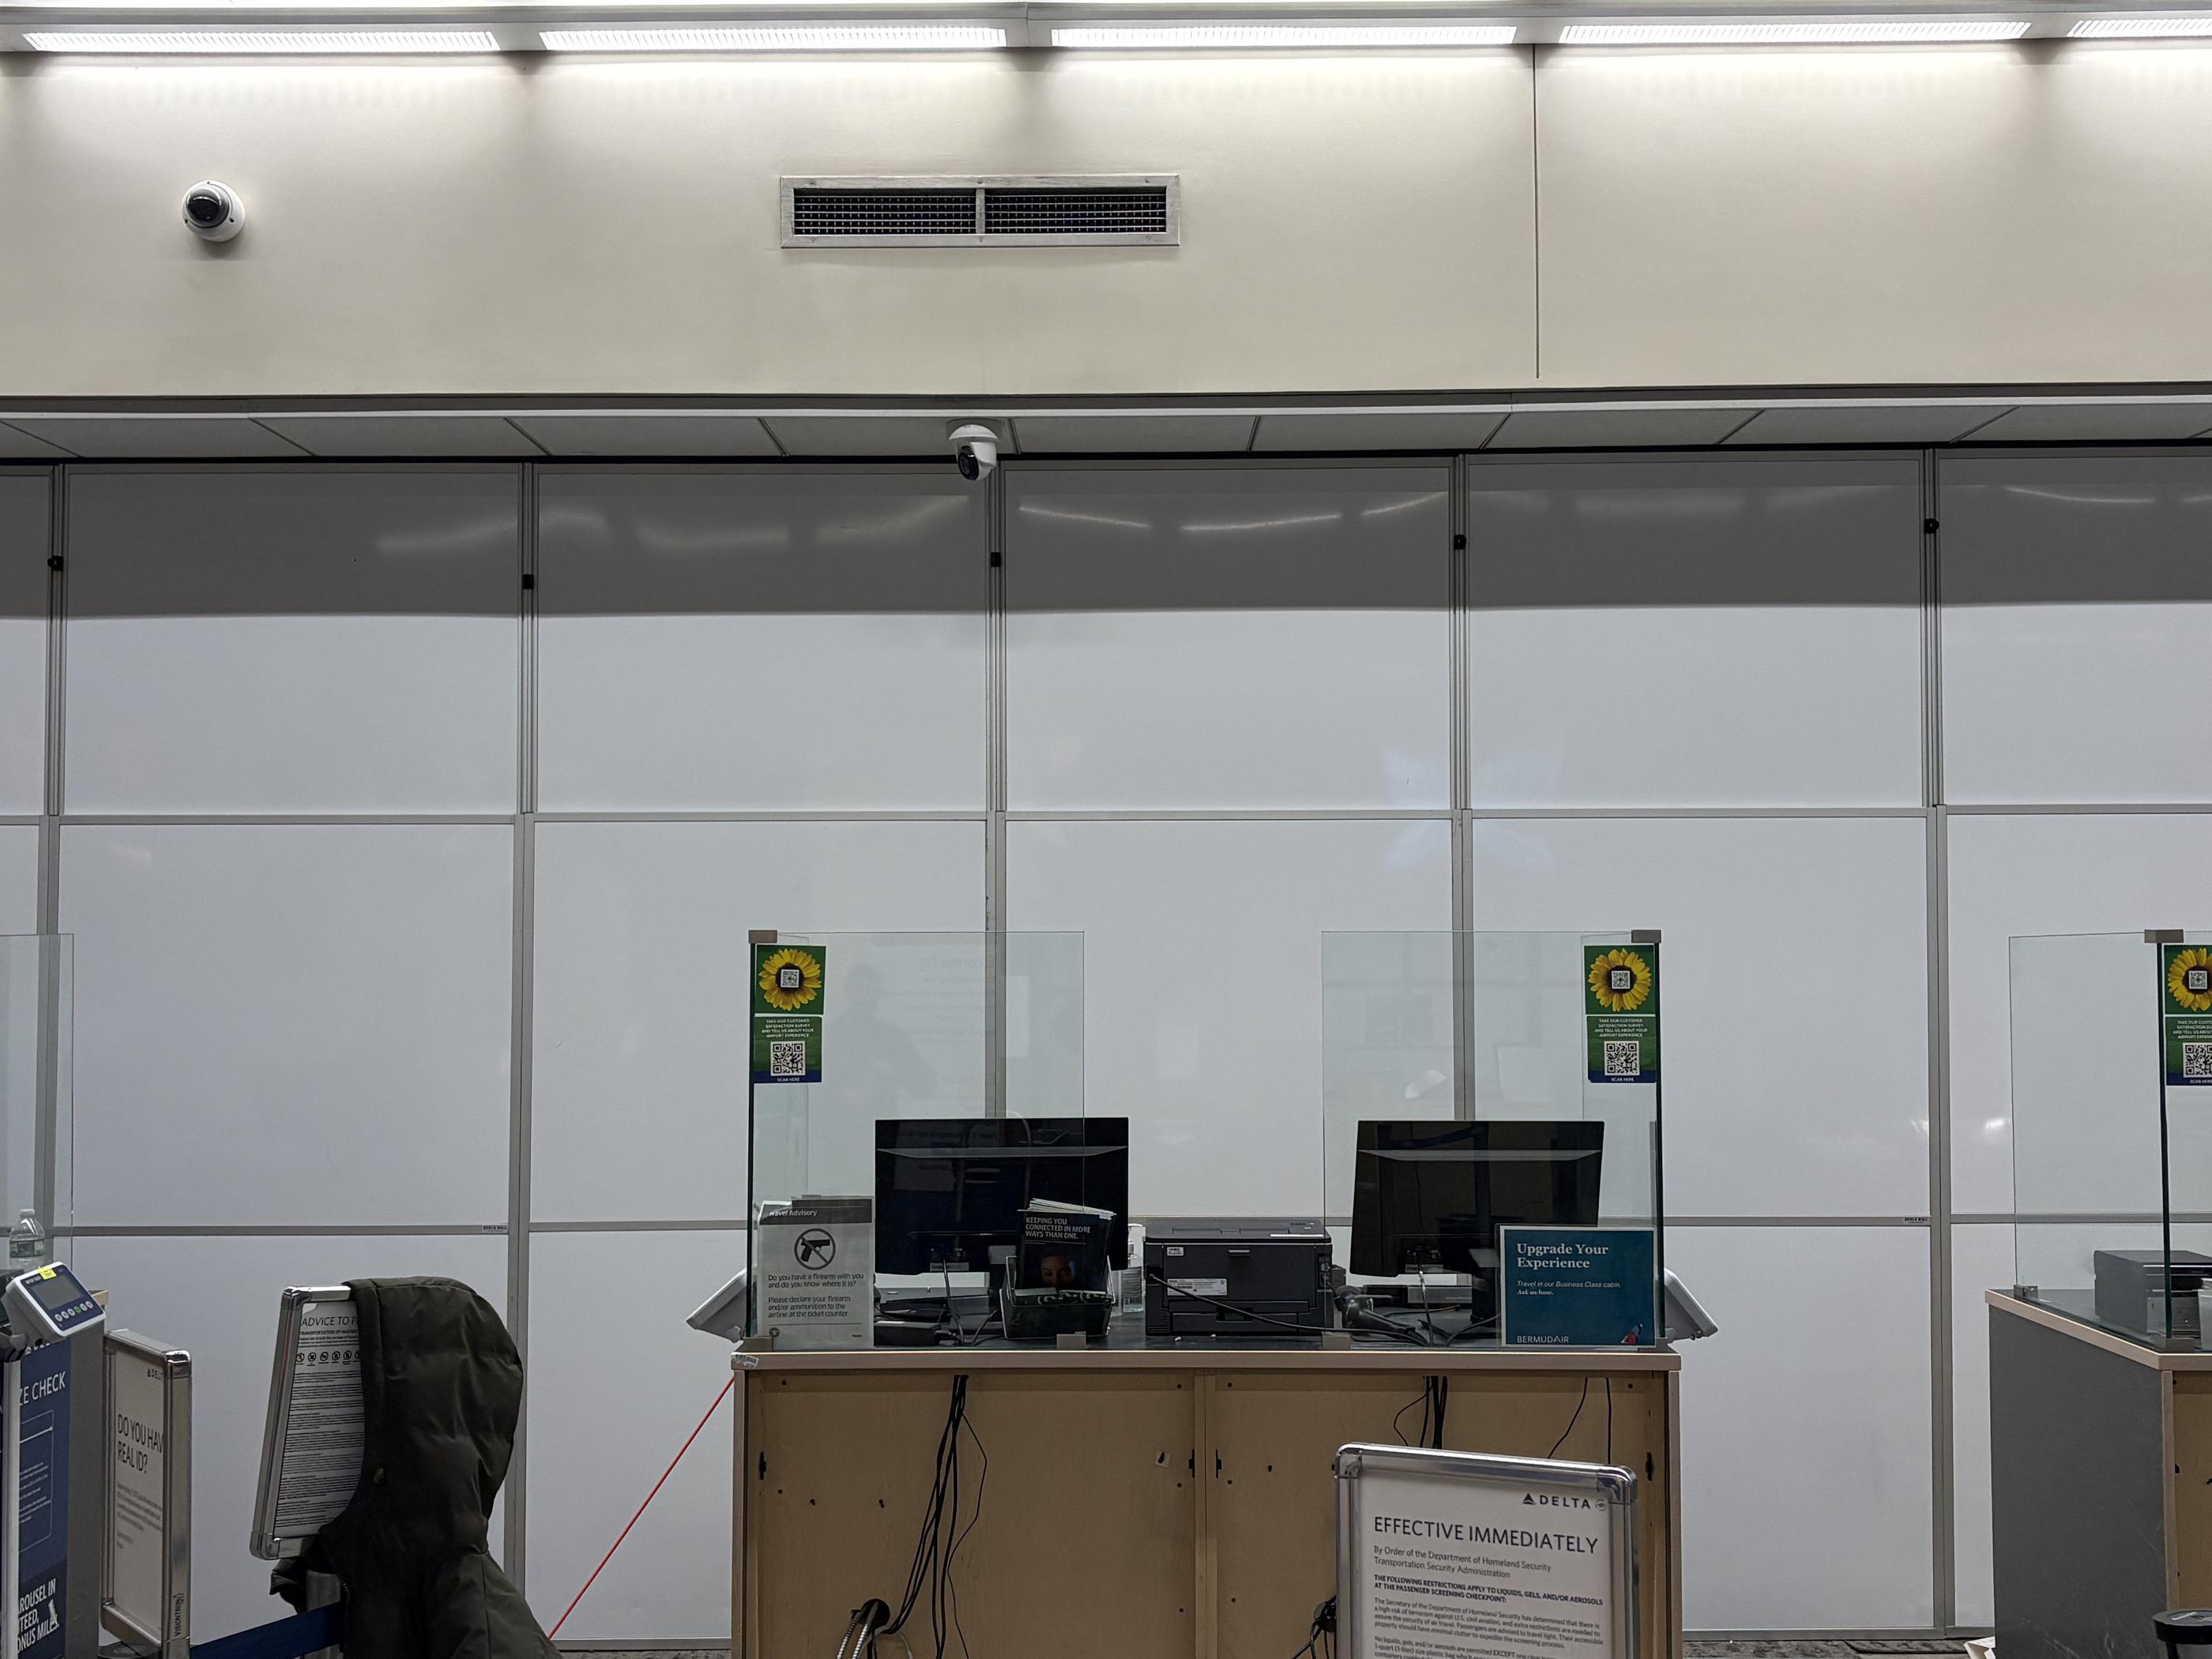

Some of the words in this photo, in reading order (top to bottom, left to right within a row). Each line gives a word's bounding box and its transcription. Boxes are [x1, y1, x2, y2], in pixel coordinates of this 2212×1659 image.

[1517, 1243, 1573, 1255] Upgrade
[1576, 1244, 1608, 1255] Your
[1517, 1257, 1590, 1270] Experience
[301, 1317, 334, 1326] ADVICE
[338, 1317, 349, 1326] TO
[32, 1371, 65, 1400] CHECK
[118, 1414, 129, 1436] DO
[130, 1420, 145, 1445] YOU
[118, 1441, 134, 1468] REAL
[137, 1450, 147, 1474] ID?
[1540, 1495, 1590, 1509] DELTA
[1375, 1516, 1463, 1540] EFFECTIVE
[1469, 1525, 1598, 1554] IMMEDIATELY
[1375, 1545, 1382, 1555] By
[1385, 1547, 1404, 1556] Order
[1416, 1549, 1427, 1558] the
[1428, 1551, 1471, 1563] Department
[1483, 1557, 1519, 1567] Homeland
[1522, 1561, 1551, 1573] Security
[1375, 1556, 1425, 1569] Transportation
[1428, 1563, 1455, 1573] Security
[1458, 1566, 1510, 1578] Administration
[19, 1584, 47, 1614] ROUSEL
[48, 1578, 56, 1597] IN
[1387, 1576, 1422, 1586] FOLLOWING
[1424, 1580, 1465, 1590] RESTRICTIONS
[1497, 1589, 1523, 1597] LIQUIDS,
[1543, 1593, 1569, 1602] AND/OR
[1570, 1597, 1603, 1605] AEROSOLS
[1396, 1585, 1430, 1594] PASSENGER
[1431, 1589, 1465, 1598] SCREENING
[1465, 1593, 1507, 1603] CHECKPOINT:
[19, 1608, 39, 1632] TEED,
[1386, 1599, 1410, 1608] Secretary
[1429, 1604, 1461, 1613] Department
[1499, 1612, 1520, 1620] Security
[1533, 1616, 1565, 1624] determined
